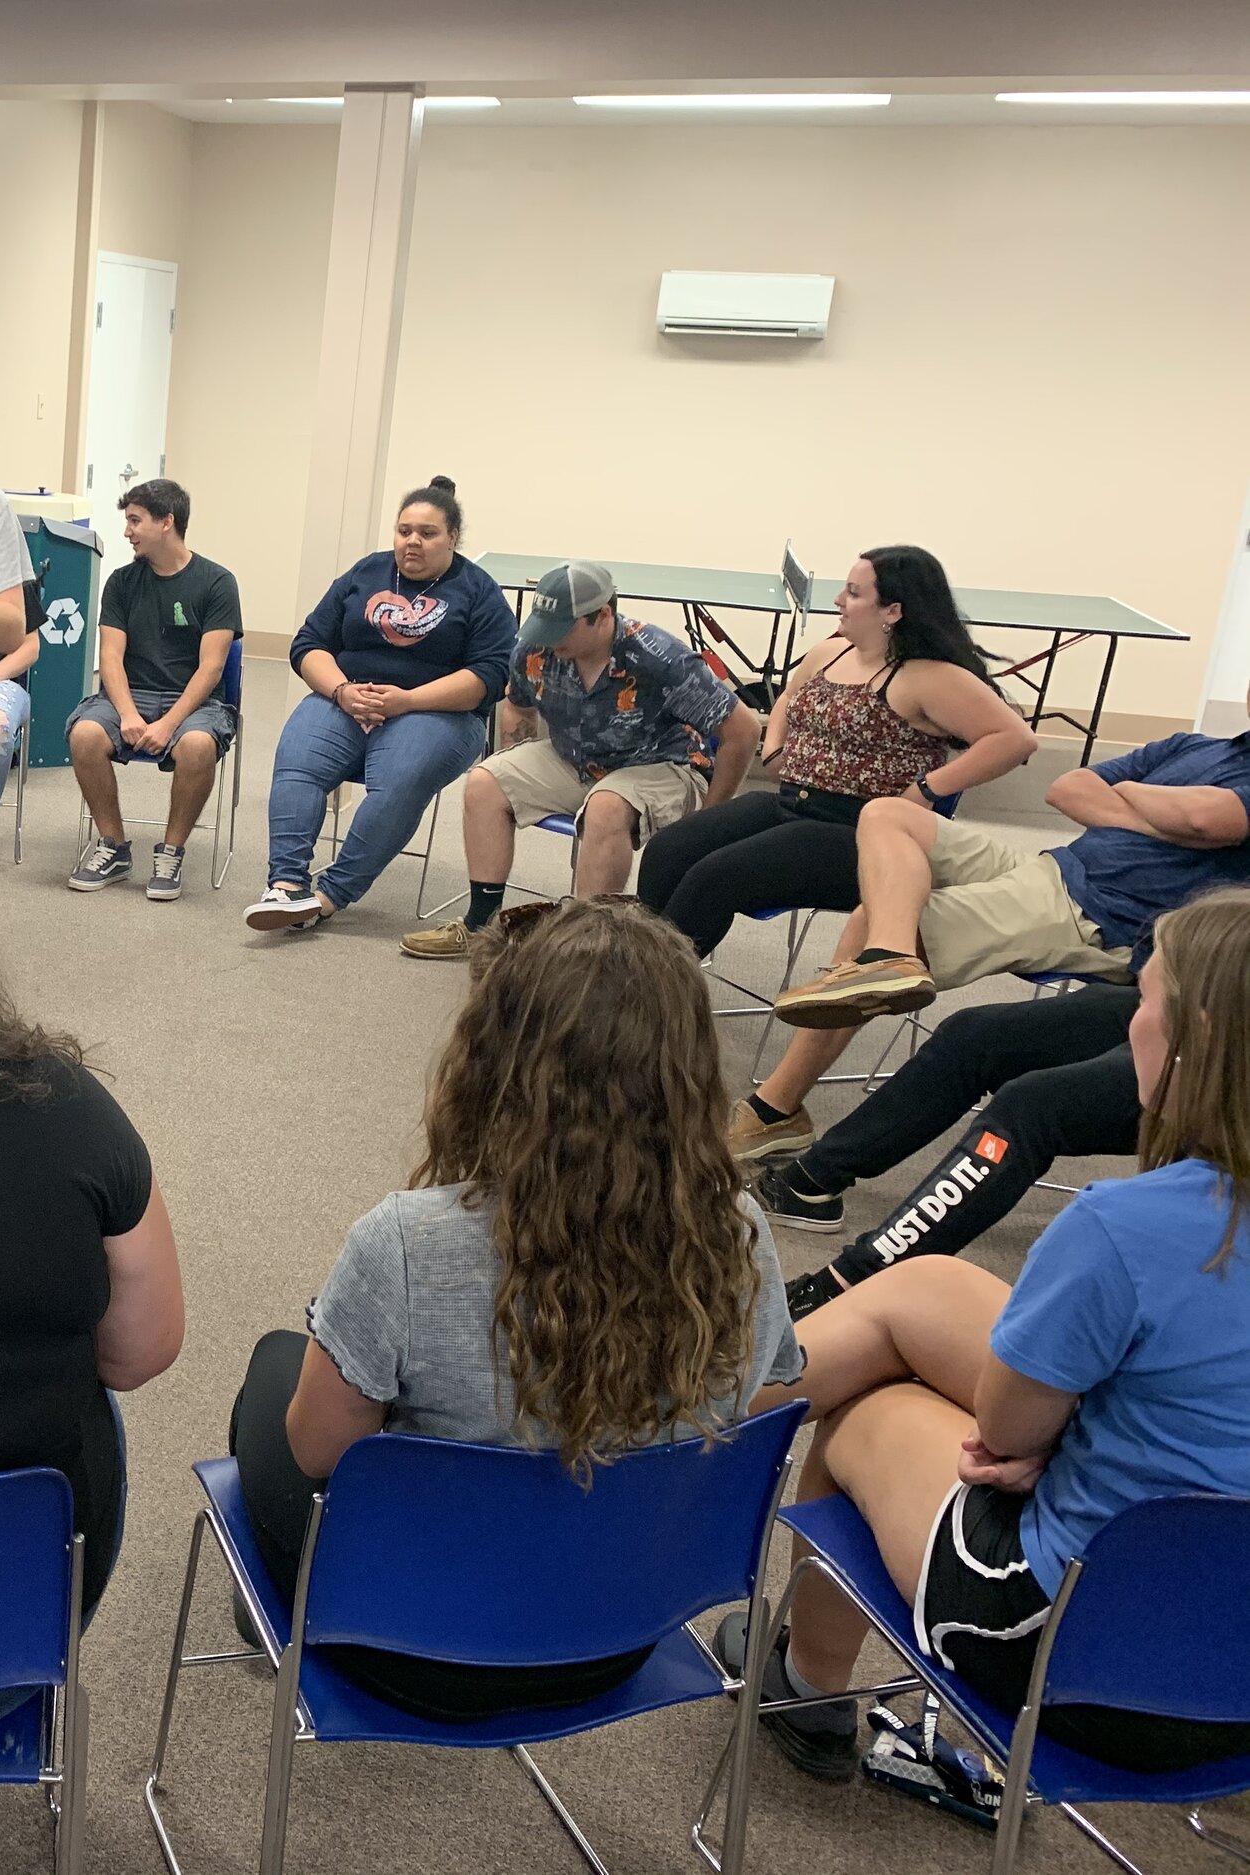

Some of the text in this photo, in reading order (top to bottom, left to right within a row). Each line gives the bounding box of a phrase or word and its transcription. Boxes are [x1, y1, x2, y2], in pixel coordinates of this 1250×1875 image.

[872, 1155, 990, 1265] JUST DO IT.
